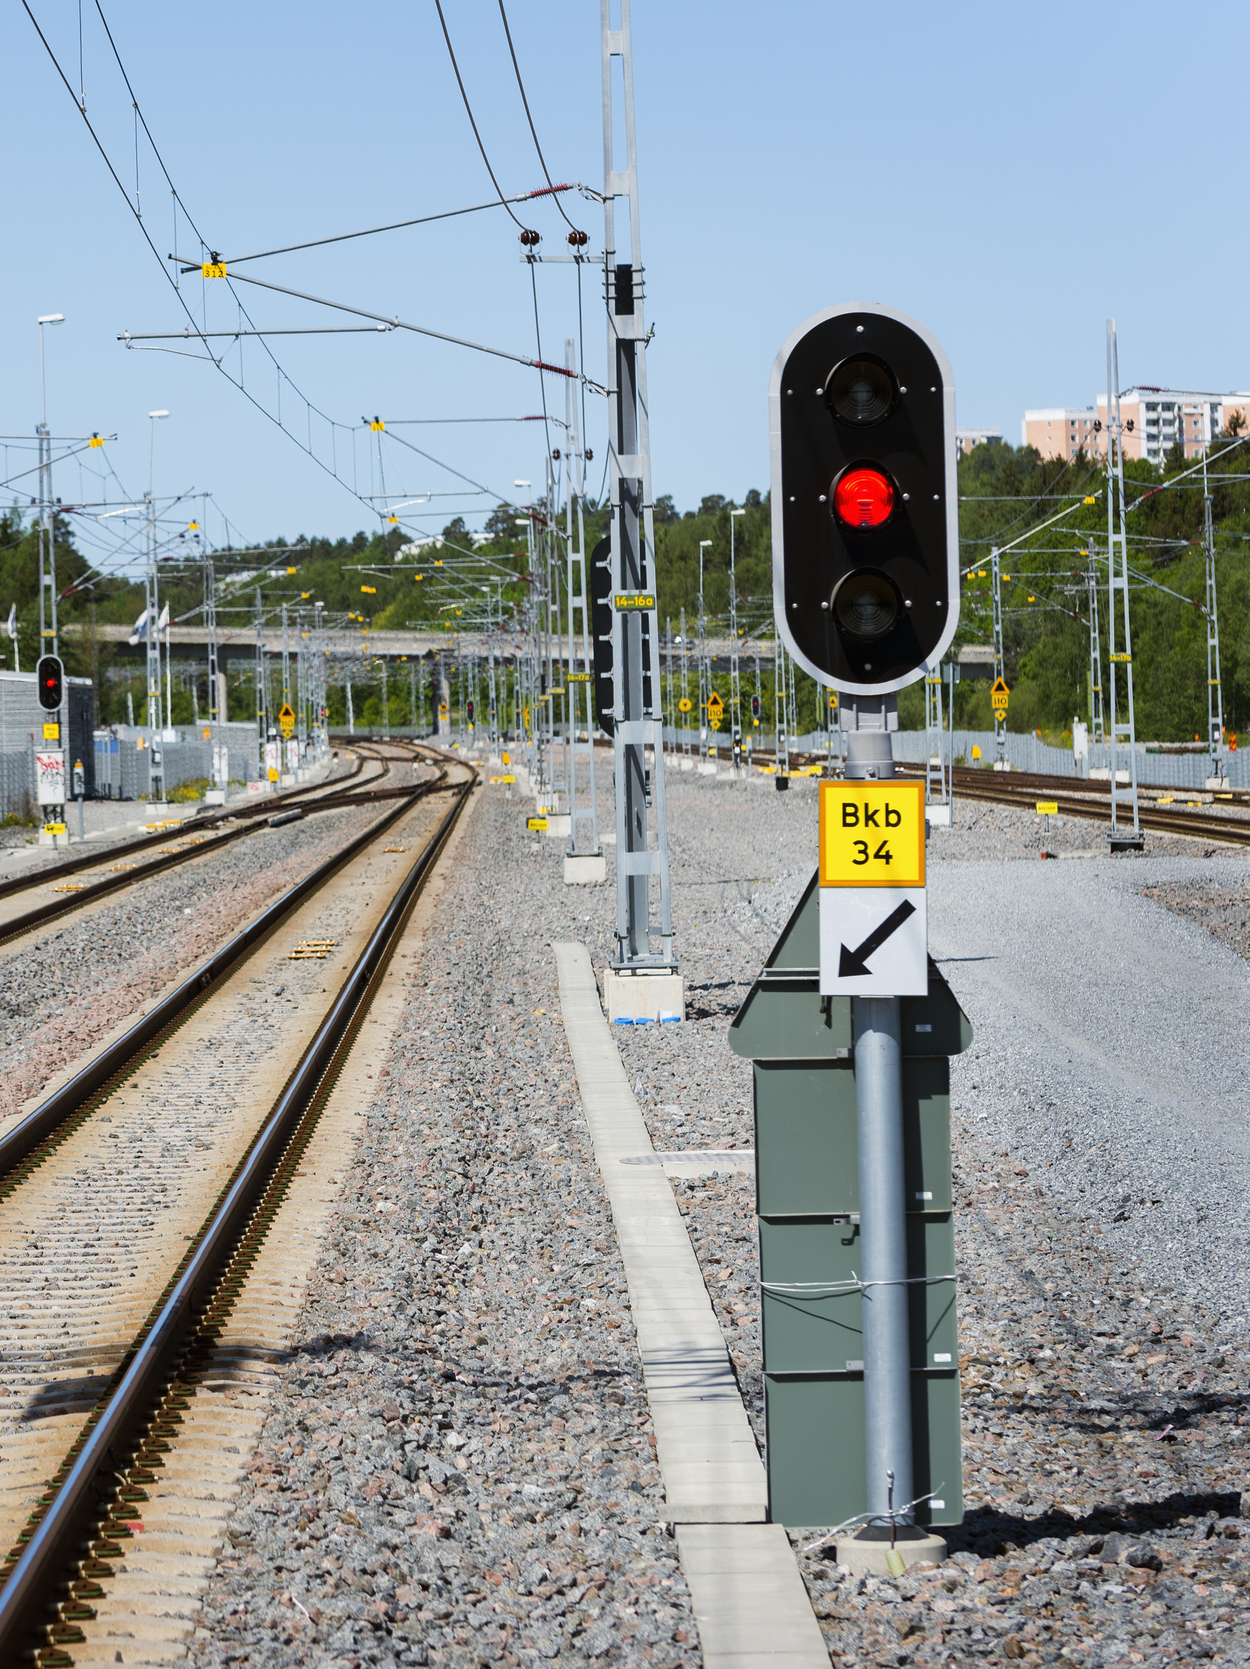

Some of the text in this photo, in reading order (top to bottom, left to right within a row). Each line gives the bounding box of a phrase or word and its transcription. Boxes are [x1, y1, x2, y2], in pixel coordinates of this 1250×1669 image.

[616, 596, 653, 607] 14-16a
[994, 697, 1007, 705] 110
[842, 802, 902, 828] Bkb
[852, 840, 893, 865] 34
